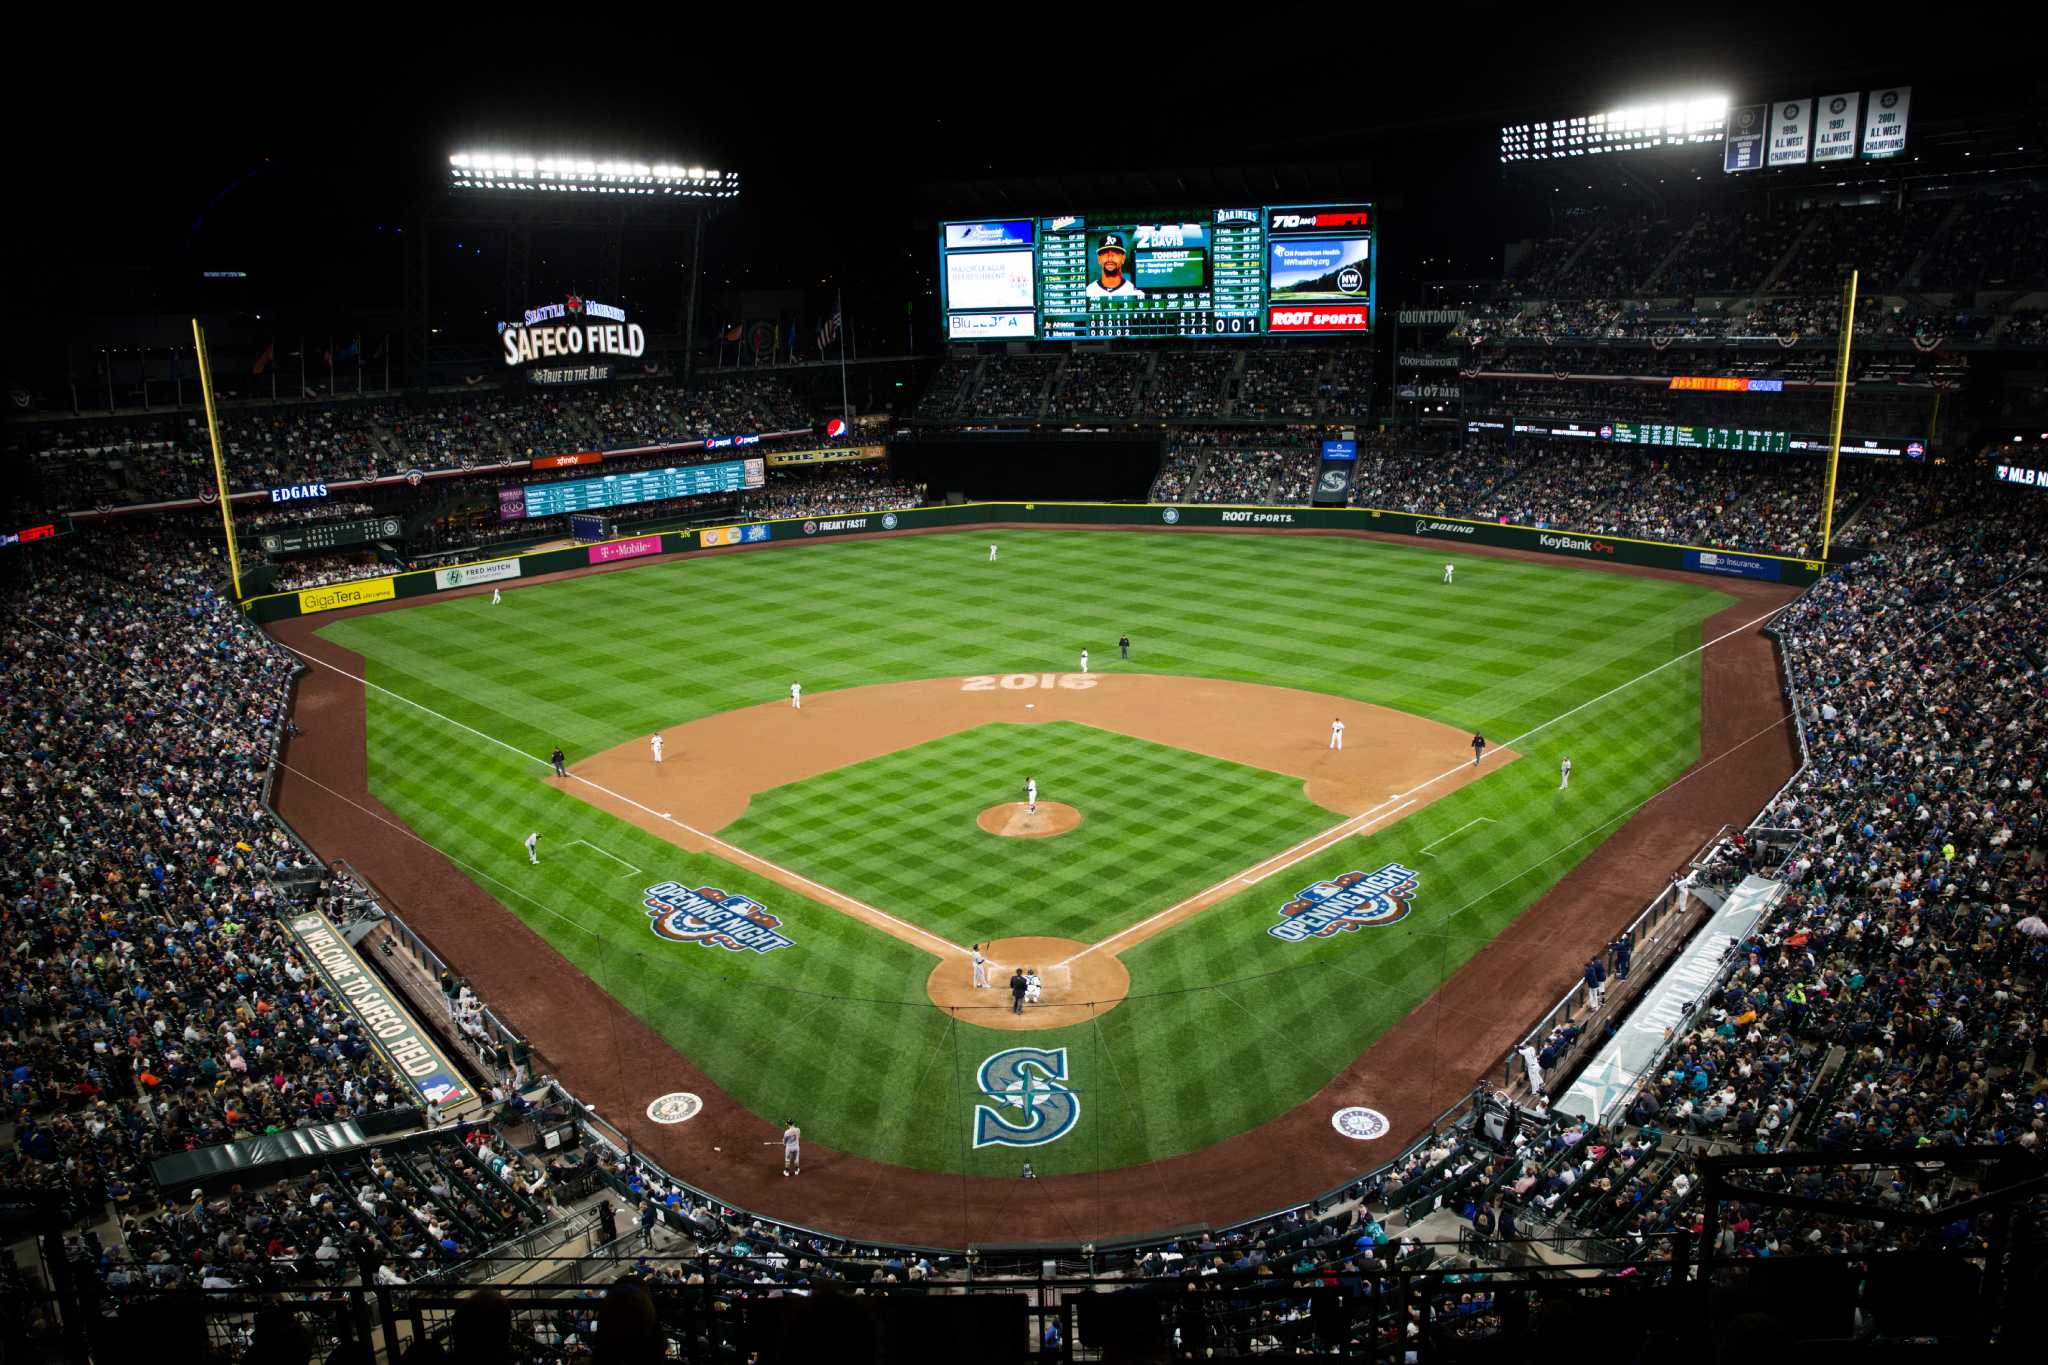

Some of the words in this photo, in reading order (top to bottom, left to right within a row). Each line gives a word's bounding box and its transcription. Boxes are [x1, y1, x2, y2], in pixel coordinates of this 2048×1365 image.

[1829, 119, 1845, 129] 1997
[1878, 113, 1896, 124] 2001
[1782, 125, 1798, 135] 1995
[1882, 125, 1901, 136] WEST
[1786, 136, 1803, 147] WEST
[1832, 131, 1851, 142] WEST
[1865, 139, 1904, 151] CHAMPIONS
[1770, 151, 1806, 162] CHAMPIONS
[1816, 145, 1853, 158] CHAMPIONS
[1218, 209, 1257, 222] MARINERS
[1272, 216, 1300, 228] 710
[1152, 240, 1184, 248] DAVIS
[1342, 274, 1358, 284] NW
[525, 304, 564, 326] SEATTLE
[586, 300, 626, 322] MARINERS
[1272, 312, 1313, 325] ROOT
[1400, 310, 1464, 323] COUNTDOWN
[1216, 319, 1224, 332] 0
[1232, 319, 1240, 332] 0
[1249, 319, 1254, 331] 1
[504, 326, 582, 366] SAFECO
[586, 323, 645, 357] FIELD
[1400, 356, 1458, 366] COOPERSTOWN
[543, 368, 563, 384] TRUE
[564, 370, 573, 382] TO
[575, 369, 588, 381] THE
[589, 366, 608, 380] BLUE
[1417, 385, 1439, 397] 107
[1440, 387, 1460, 397] DAYS
[715, 438, 731, 448] pepsi
[744, 436, 759, 444] pepsi
[557, 456, 578, 465] xfinity
[775, 454, 813, 462] THE
[2009, 467, 2035, 484] MLB
[272, 484, 327, 502] EDGARS
[501, 502, 523, 512] EQC
[1222, 512, 1253, 521] ROOT
[820, 521, 845, 531] FREAKY
[846, 519, 866, 528] FAST!
[1430, 522, 1475, 534] BOEING
[1540, 534, 1592, 551] KeyBank
[1727, 558, 1761, 569] Insurance
[466, 567, 484, 576] FRED
[487, 564, 510, 573] HUTCH
[305, 592, 360, 608] GigaTera
[961, 674, 1098, 691] 2016
[1272, 893, 1365, 940] OPENING
[1354, 865, 1413, 897] NIGHT
[650, 882, 734, 923] OPENING
[718, 917, 790, 950] NIGHT
[302, 928, 360, 980] WELCOME
[341, 975, 373, 996] TO
[353, 992, 407, 1038] SAFECO
[387, 1036, 438, 1077] FIELD
